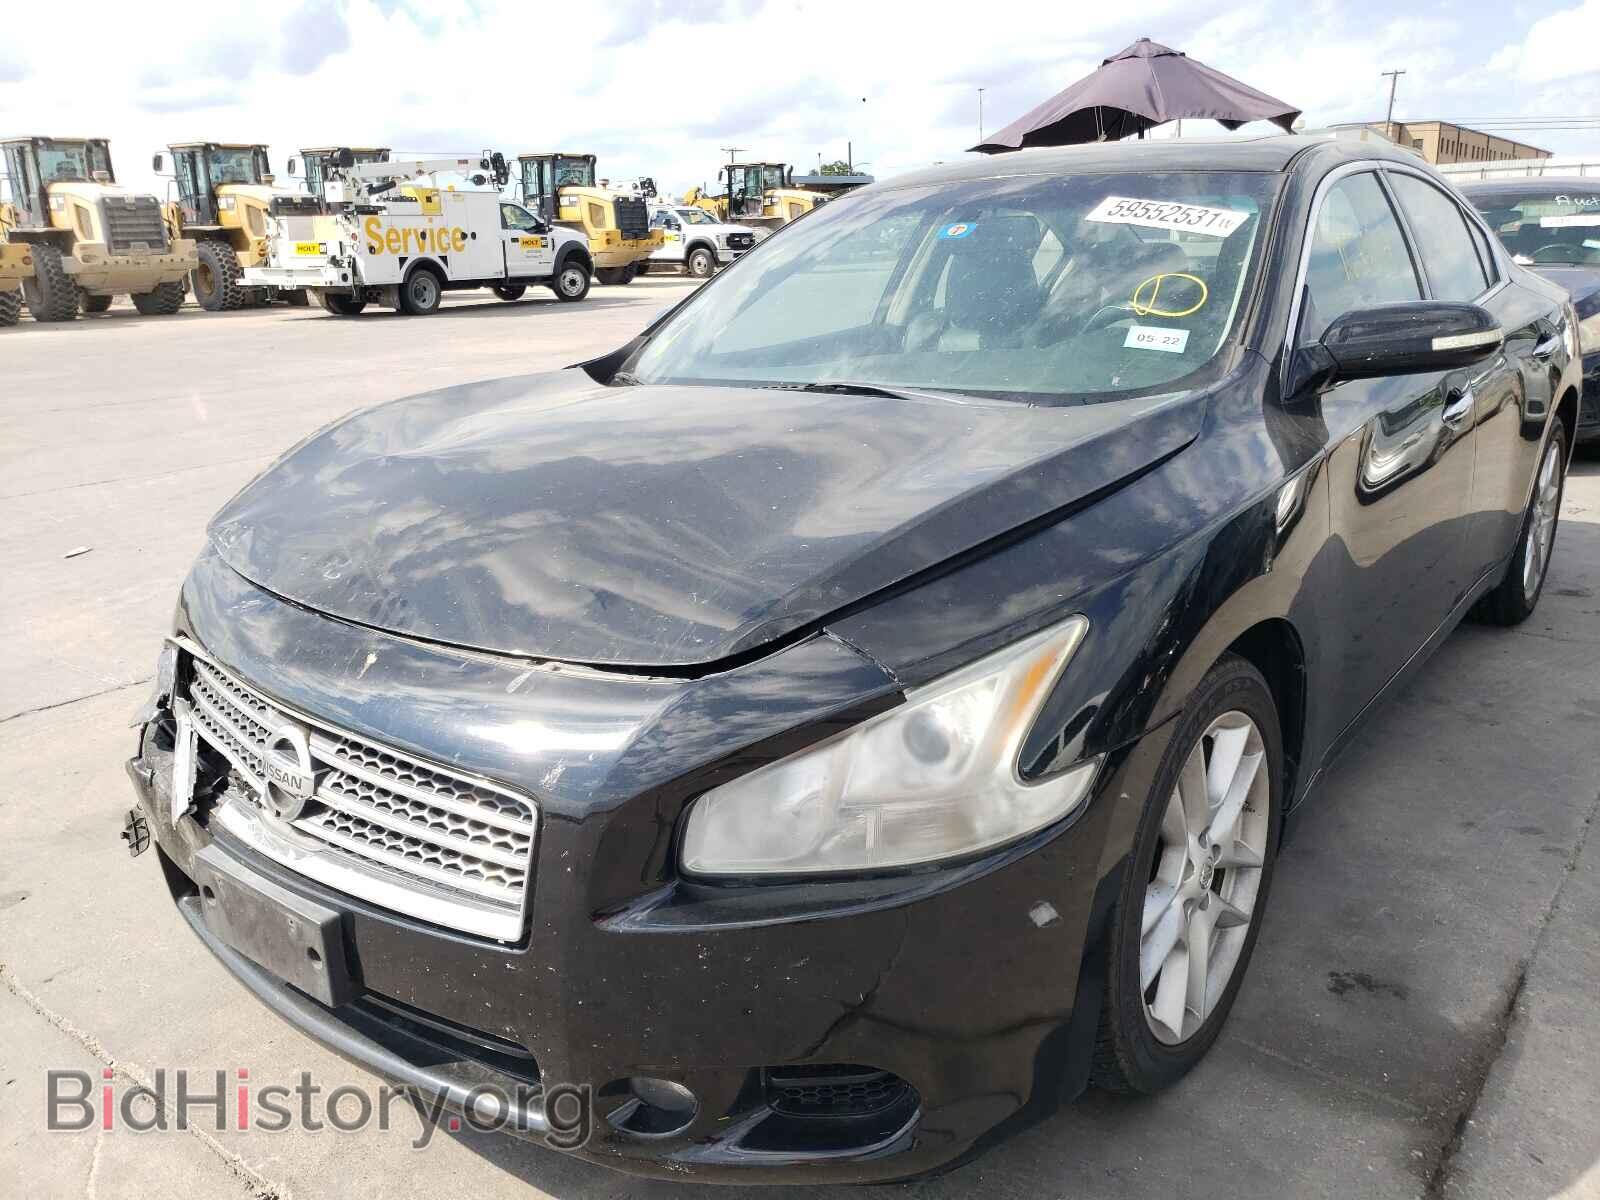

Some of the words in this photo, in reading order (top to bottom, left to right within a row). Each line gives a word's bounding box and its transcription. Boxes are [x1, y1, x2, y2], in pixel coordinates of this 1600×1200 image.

[1107, 199, 1223, 227] 59552531
[365, 216, 466, 255] Service
[297, 244, 316, 252] HOLT
[522, 239, 539, 247] HOLT
[1137, 332, 1155, 344] 05
[1162, 335, 1181, 346] 22
